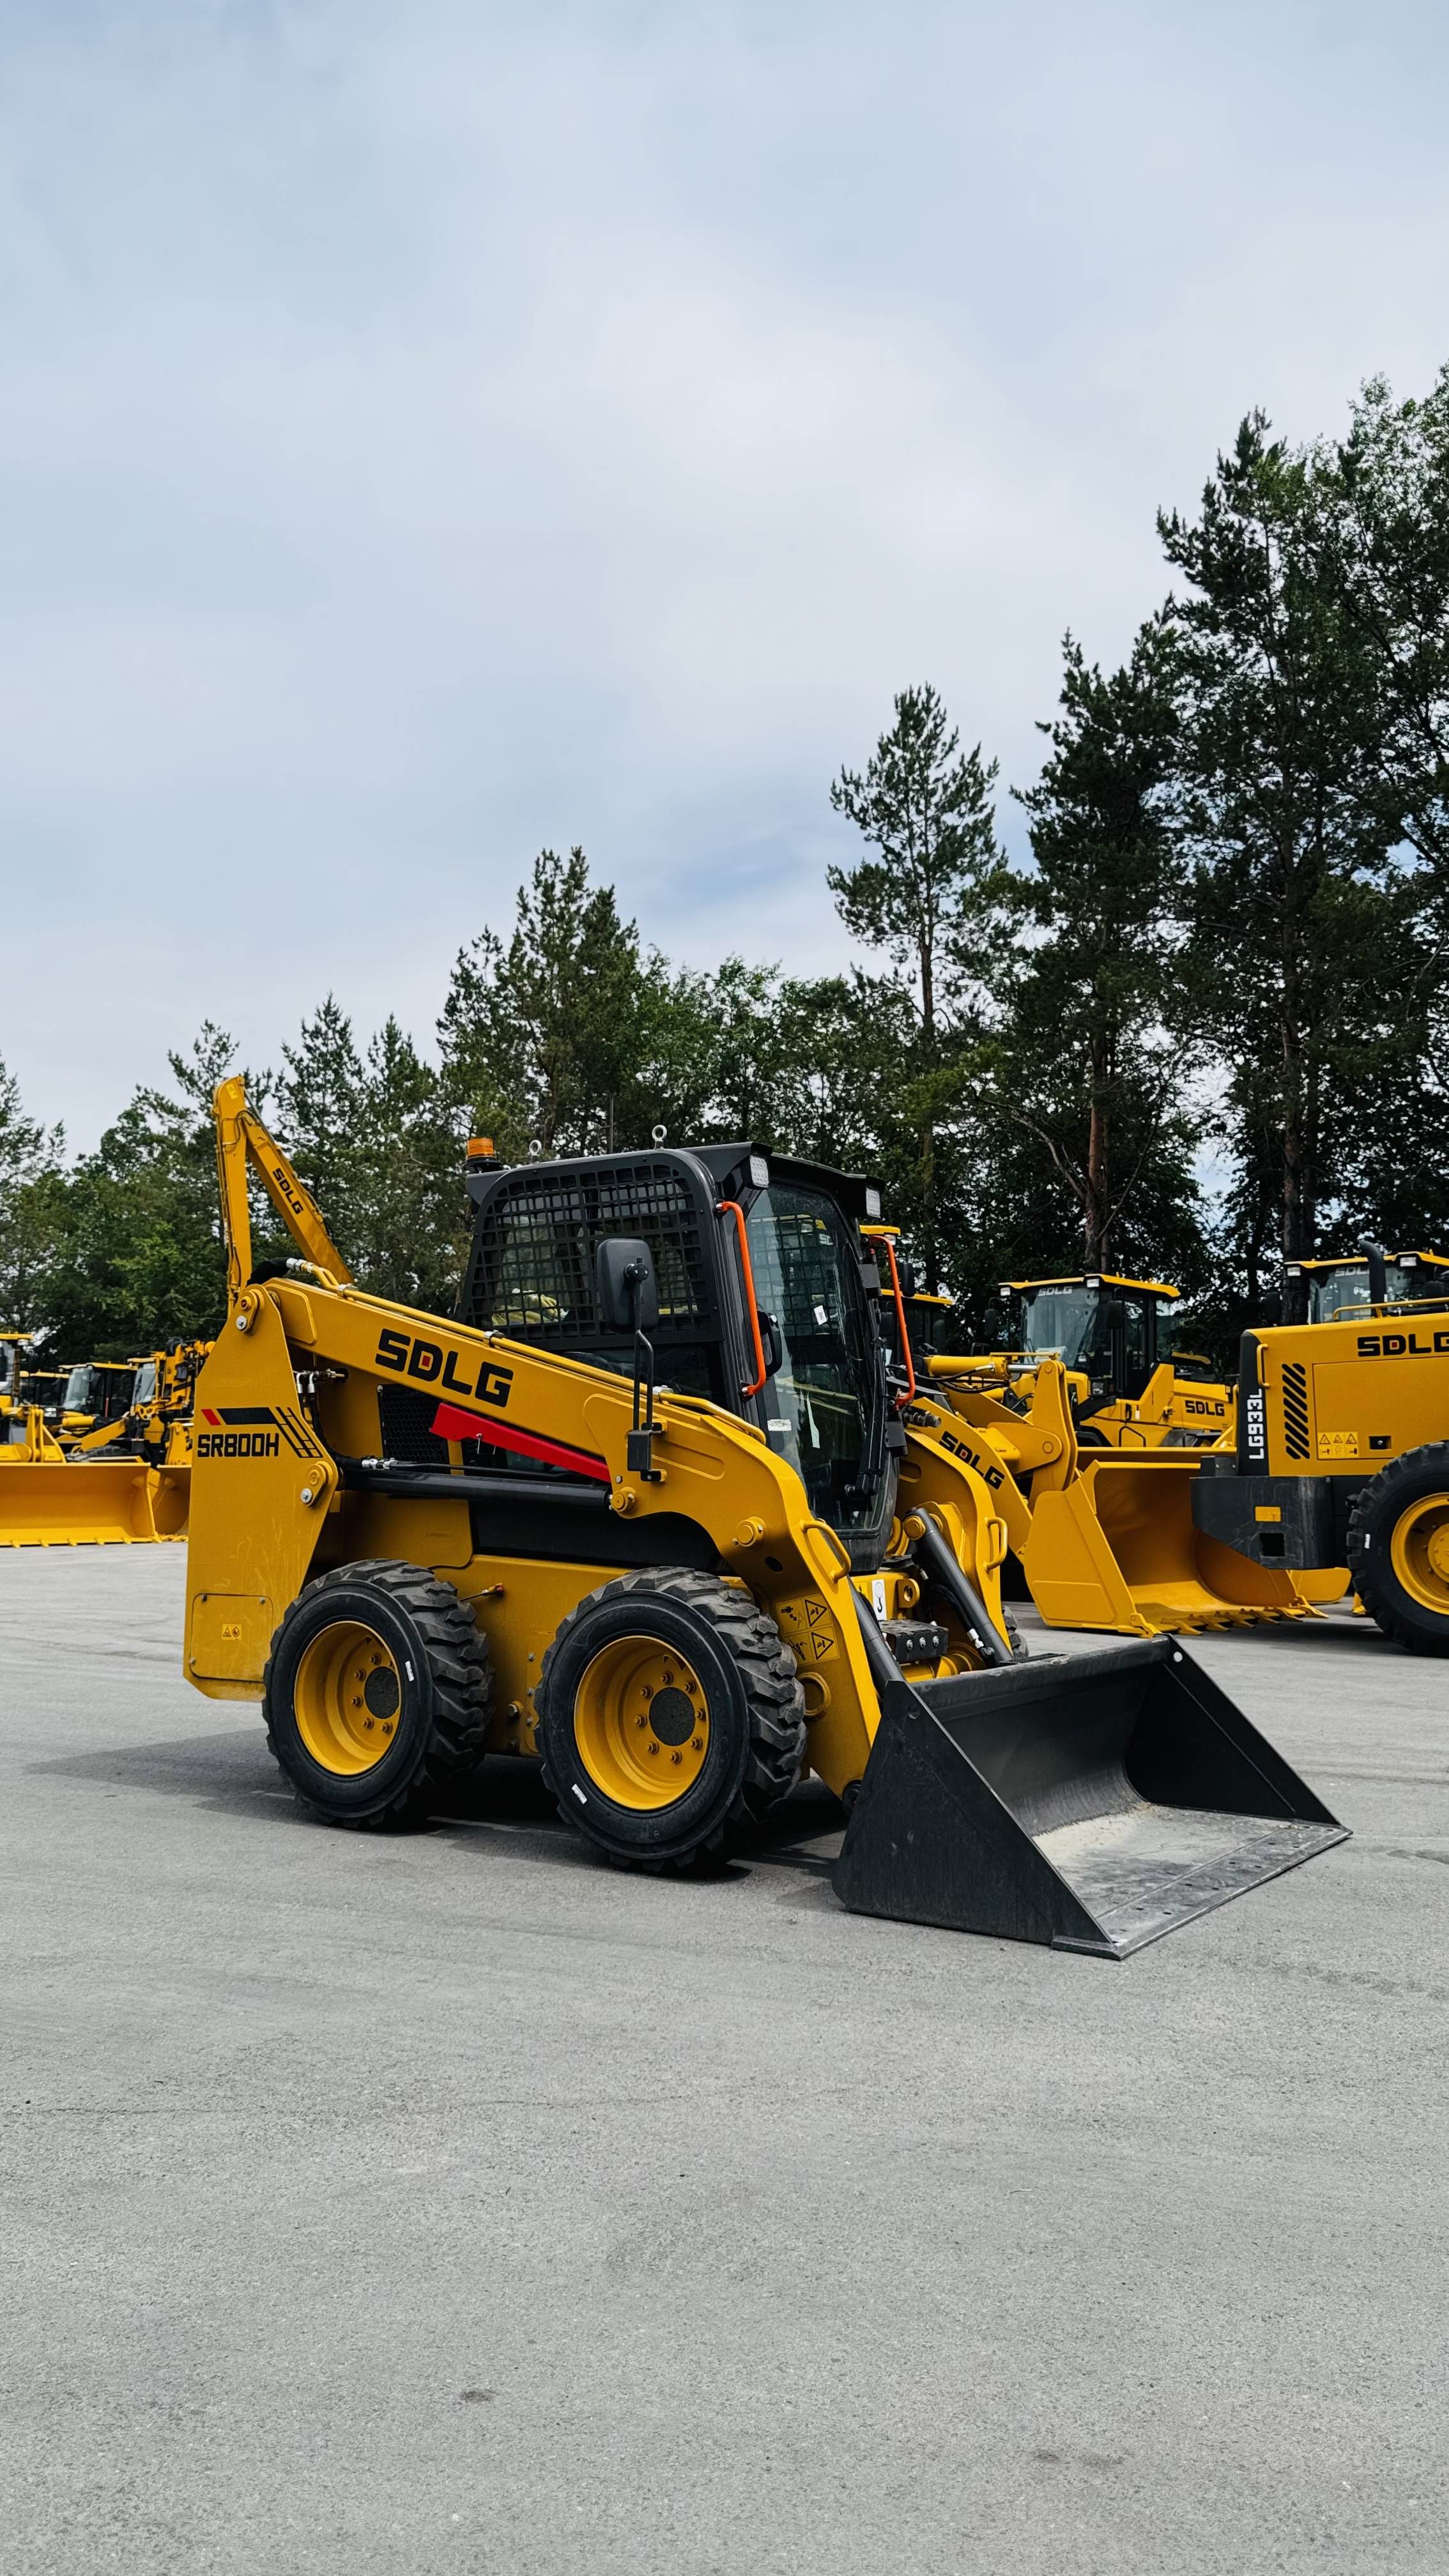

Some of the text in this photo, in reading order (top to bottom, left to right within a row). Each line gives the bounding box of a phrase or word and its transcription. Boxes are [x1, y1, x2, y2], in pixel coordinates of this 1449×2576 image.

[272, 1168, 303, 1215] SDLG
[1334, 1266, 1370, 1277] SDL
[1038, 1286, 1073, 1297] SDLG
[375, 1328, 514, 1408] SDLG
[1184, 1400, 1225, 1416] SDLG
[1246, 1388, 1264, 1459] LG933L
[197, 1433, 279, 1457] SR800H
[939, 1430, 1005, 1490] SDLG
